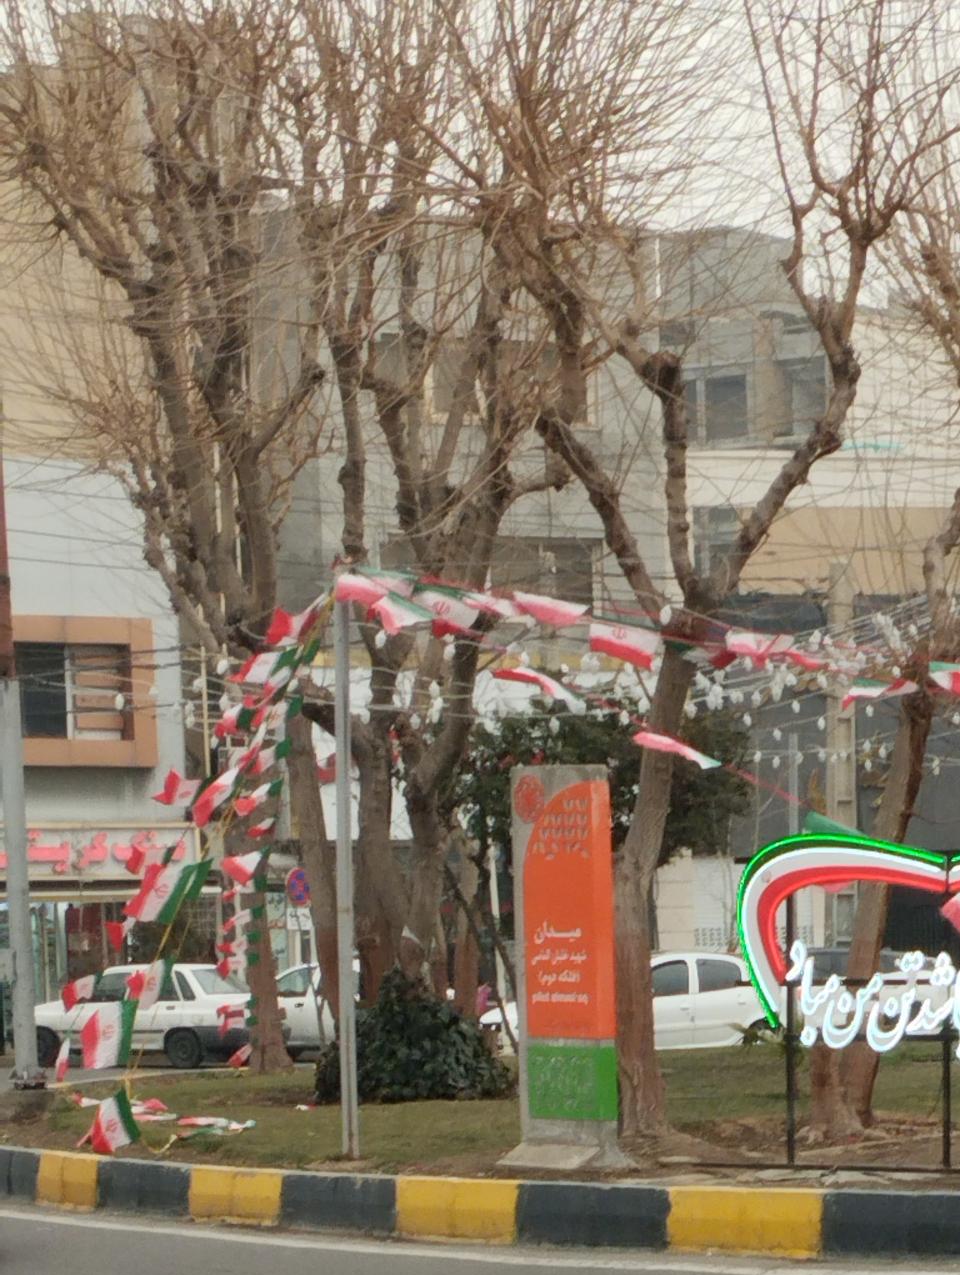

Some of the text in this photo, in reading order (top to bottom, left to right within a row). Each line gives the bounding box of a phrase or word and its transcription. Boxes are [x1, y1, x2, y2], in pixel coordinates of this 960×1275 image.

[534, 921, 582, 944] میدان
[785, 938, 841, 1048] مباد
[821, 971, 884, 1049] من
[865, 949, 926, 1053] تن
